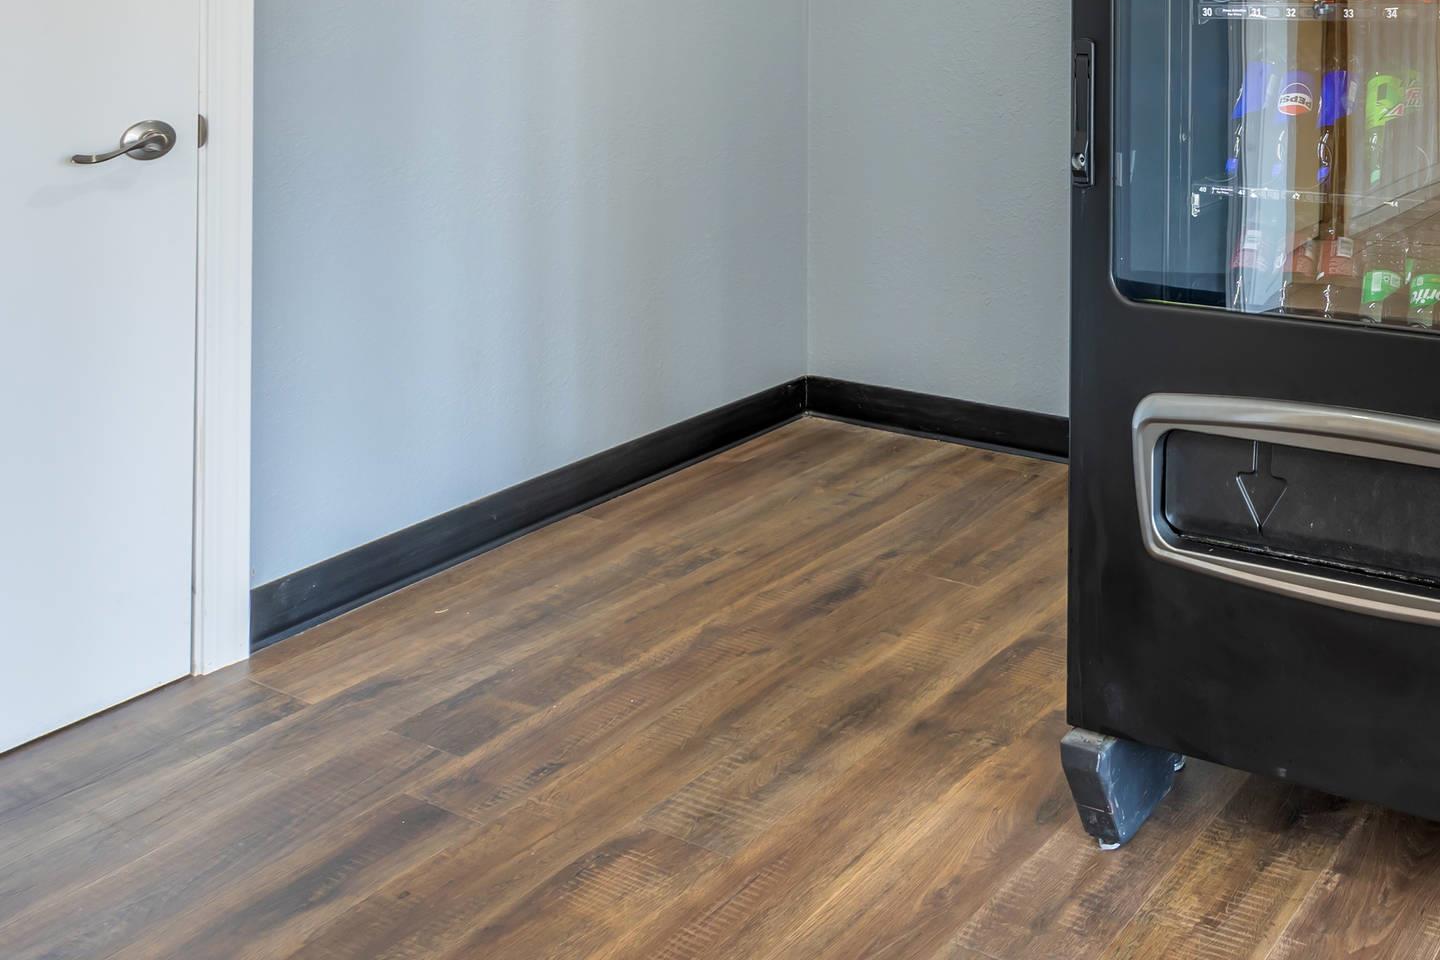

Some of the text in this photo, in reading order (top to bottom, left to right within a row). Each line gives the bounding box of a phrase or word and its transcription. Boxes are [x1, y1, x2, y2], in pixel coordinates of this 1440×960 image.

[1202, 7, 1213, 17] 30
[1286, 8, 1296, 18] 32
[1343, 9, 1354, 18] 33
[1386, 9, 1397, 19] 34
